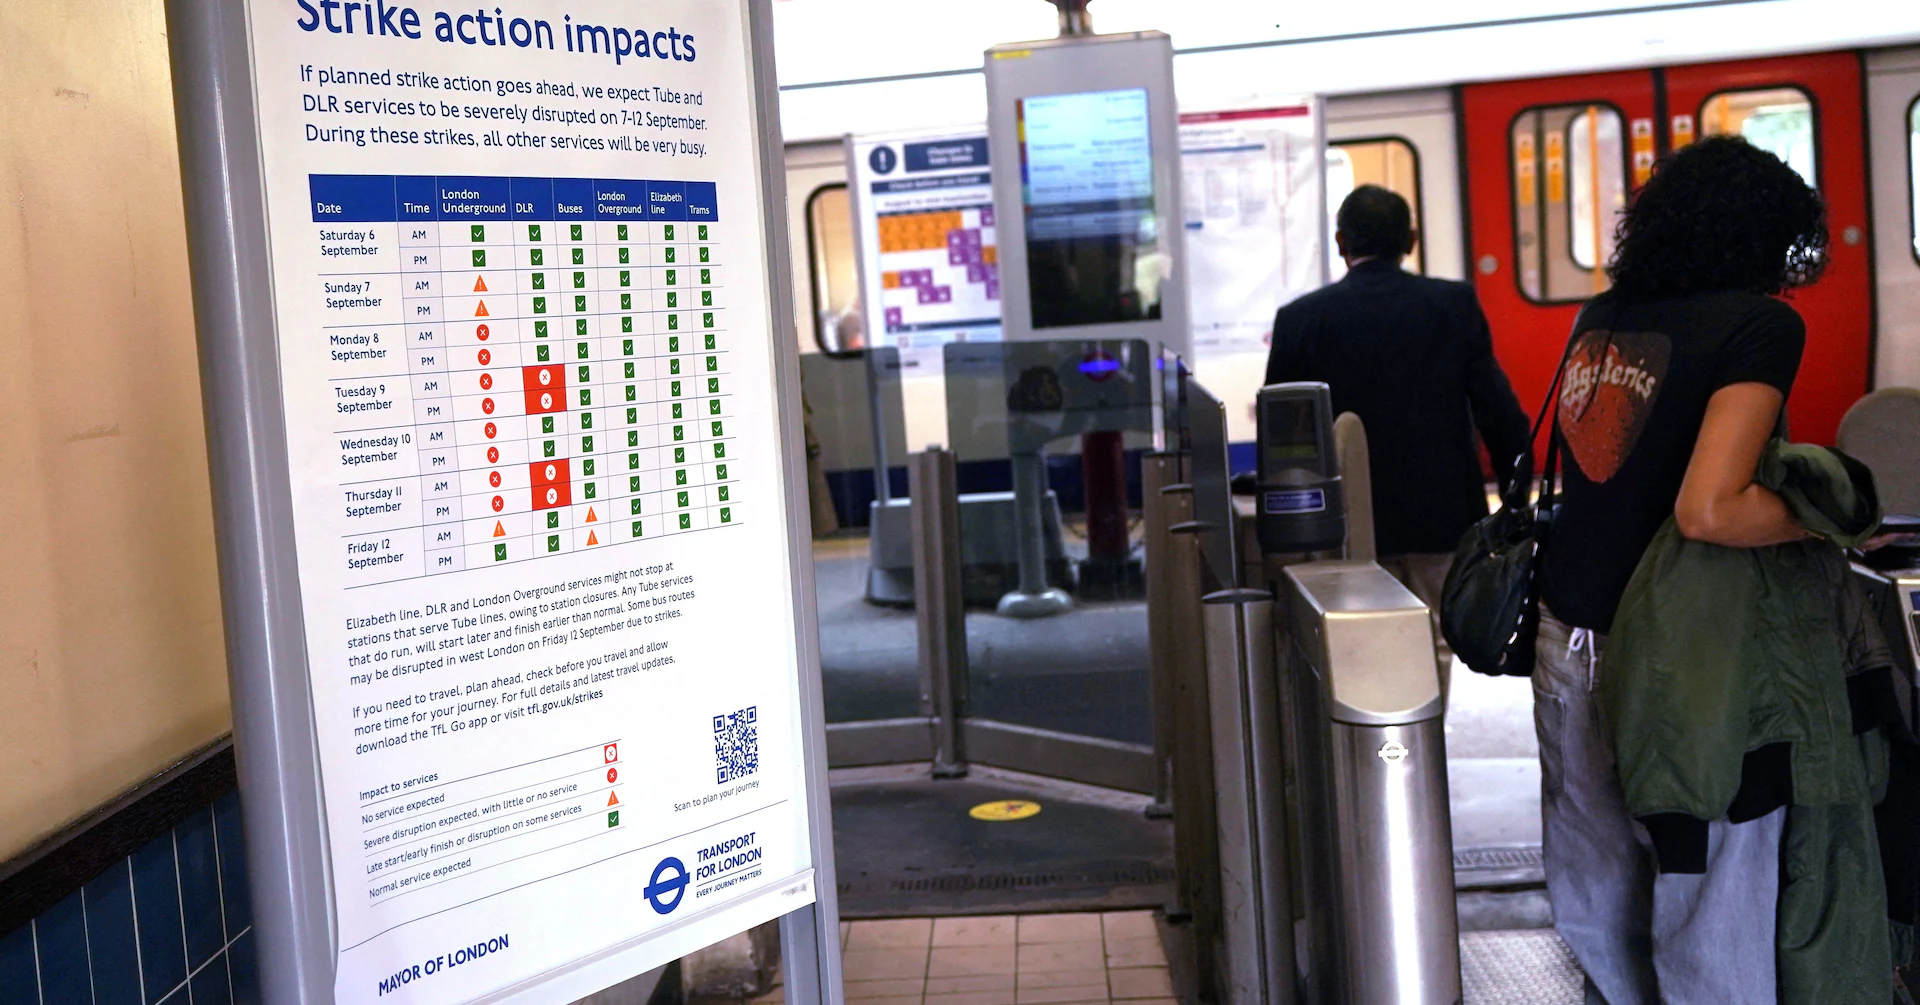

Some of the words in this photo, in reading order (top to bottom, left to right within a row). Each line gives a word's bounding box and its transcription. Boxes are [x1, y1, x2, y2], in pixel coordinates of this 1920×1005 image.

[297, 0, 422, 40] Strike
[434, 7, 554, 50] action
[564, 14, 696, 66] impacts
[300, 64, 313, 82] If
[318, 66, 391, 87] planned
[396, 71, 439, 89] strike
[443, 76, 492, 92] action
[496, 80, 532, 97] goes
[536, 79, 580, 99] ahead,
[581, 86, 603, 99] we
[607, 87, 651, 104] expect
[652, 86, 681, 104] Tube
[683, 91, 703, 106] and
[303, 94, 340, 113] DLR
[344, 98, 415, 116] services
[418, 101, 436, 117] to
[440, 100, 460, 118] be
[463, 104, 528, 124] severely
[532, 105, 596, 127] disrupted
[600, 113, 618, 125] on
[621, 110, 643, 126] 7-12
[646, 111, 708, 131] September.
[305, 123, 366, 147] During
[369, 126, 419, 144] these
[423, 128, 480, 148] strikes,
[483, 130, 503, 147] all
[506, 131, 547, 148] other
[550, 134, 605, 150] services
[607, 135, 632, 151] will
[634, 136, 650, 152] be
[652, 141, 677, 157] very
[680, 139, 708, 158] busy.
[442, 189, 480, 199] London
[597, 191, 625, 201] London
[650, 192, 682, 202] Elizabeth
[317, 202, 342, 213] Date
[403, 203, 430, 213] Time
[443, 202, 506, 215] Underground
[516, 203, 534, 213] DLR
[558, 203, 583, 213] Buses
[598, 203, 642, 216] Overground
[651, 204, 665, 214] line
[689, 205, 710, 214] Trams
[319, 230, 366, 243] Saturday
[369, 229, 375, 240] 6
[412, 230, 426, 239] AM
[321, 245, 378, 258] September
[414, 255, 427, 265] PM
[324, 282, 362, 295] Sunday
[364, 281, 370, 292] 7
[415, 281, 429, 290] AM
[326, 296, 382, 310] September
[417, 306, 431, 316] PM
[330, 334, 370, 347] Monday
[373, 333, 379, 343] 8
[418, 331, 433, 341] AM
[331, 348, 387, 363] September
[421, 356, 435, 366] PM
[334, 385, 377, 399] Tuesday
[379, 384, 385, 395] 9
[424, 381, 438, 391] AM
[337, 399, 393, 415] September
[427, 406, 441, 416] PM
[340, 435, 399, 450] Wednesday
[401, 433, 411, 444] 10
[429, 431, 443, 441] AM
[341, 451, 398, 467] September
[432, 456, 446, 466] PM
[434, 481, 448, 492] AM
[345, 488, 393, 502] Thursday
[396, 486, 402, 496] 11
[346, 502, 402, 518] September
[436, 506, 450, 516] PM
[437, 531, 451, 542] AM
[348, 541, 379, 554] Friday
[381, 538, 390, 549] 12
[348, 553, 404, 570] September
[438, 556, 452, 566] PM
[348, 653, 371, 667] that
[374, 650, 388, 662] do
[391, 647, 414, 659] run,
[415, 640, 436, 654] will
[438, 636, 464, 650] start
[467, 632, 491, 645] later
[493, 626, 512, 640] and
[514, 621, 540, 635] finish
[542, 616, 570, 630] earlier
[572, 612, 592, 623] than
[593, 603, 627, 618] normal.
[627, 599, 651, 611] Some
[652, 596, 667, 606] bus
[668, 590, 695, 602] routes
[356, 732, 407, 755] download
[410, 729, 428, 741] the
[430, 724, 448, 736] TfL
[450, 720, 466, 732] Go
[468, 717, 488, 729] app
[490, 713, 502, 723] or
[504, 707, 525, 720] visit
[527, 690, 603, 715] tfl.gov.uk/strikes
[359, 785, 389, 801] Impact
[390, 783, 401, 792] to
[403, 773, 438, 789] services
[674, 801, 691, 812] Scan
[692, 799, 701, 807] to
[703, 794, 718, 805] plan
[719, 788, 734, 800] your
[735, 780, 759, 795] journey
[362, 814, 374, 825] No
[375, 806, 404, 821] service
[406, 793, 445, 811] expected
[364, 834, 390, 850] Severe
[392, 821, 437, 840] disruption
[438, 808, 481, 827] expected,
[481, 803, 501, 815] with
[503, 797, 524, 809] little
[526, 795, 535, 803] or
[537, 792, 548, 800] no
[549, 784, 577, 797] service
[366, 862, 383, 874] Late
[384, 847, 428, 868] start/early
[430, 839, 454, 853] finish
[456, 837, 465, 846] or
[467, 825, 510, 843] disruption
[512, 821, 523, 830] on
[525, 814, 548, 827] some
[550, 805, 582, 820] services
[697, 831, 756, 863] TRANSPORT
[696, 863, 716, 881] FOR
[718, 846, 762, 873] LONDON
[369, 880, 398, 899] Normal
[400, 872, 431, 887] service
[433, 857, 471, 877] expected
[696, 886, 713, 898] EVERY
[714, 877, 738, 892] JOURNEY
[739, 869, 762, 882] MATTERS
[379, 965, 422, 997] MAYOR
[424, 956, 444, 975] OF
[448, 933, 509, 968] LONDON
